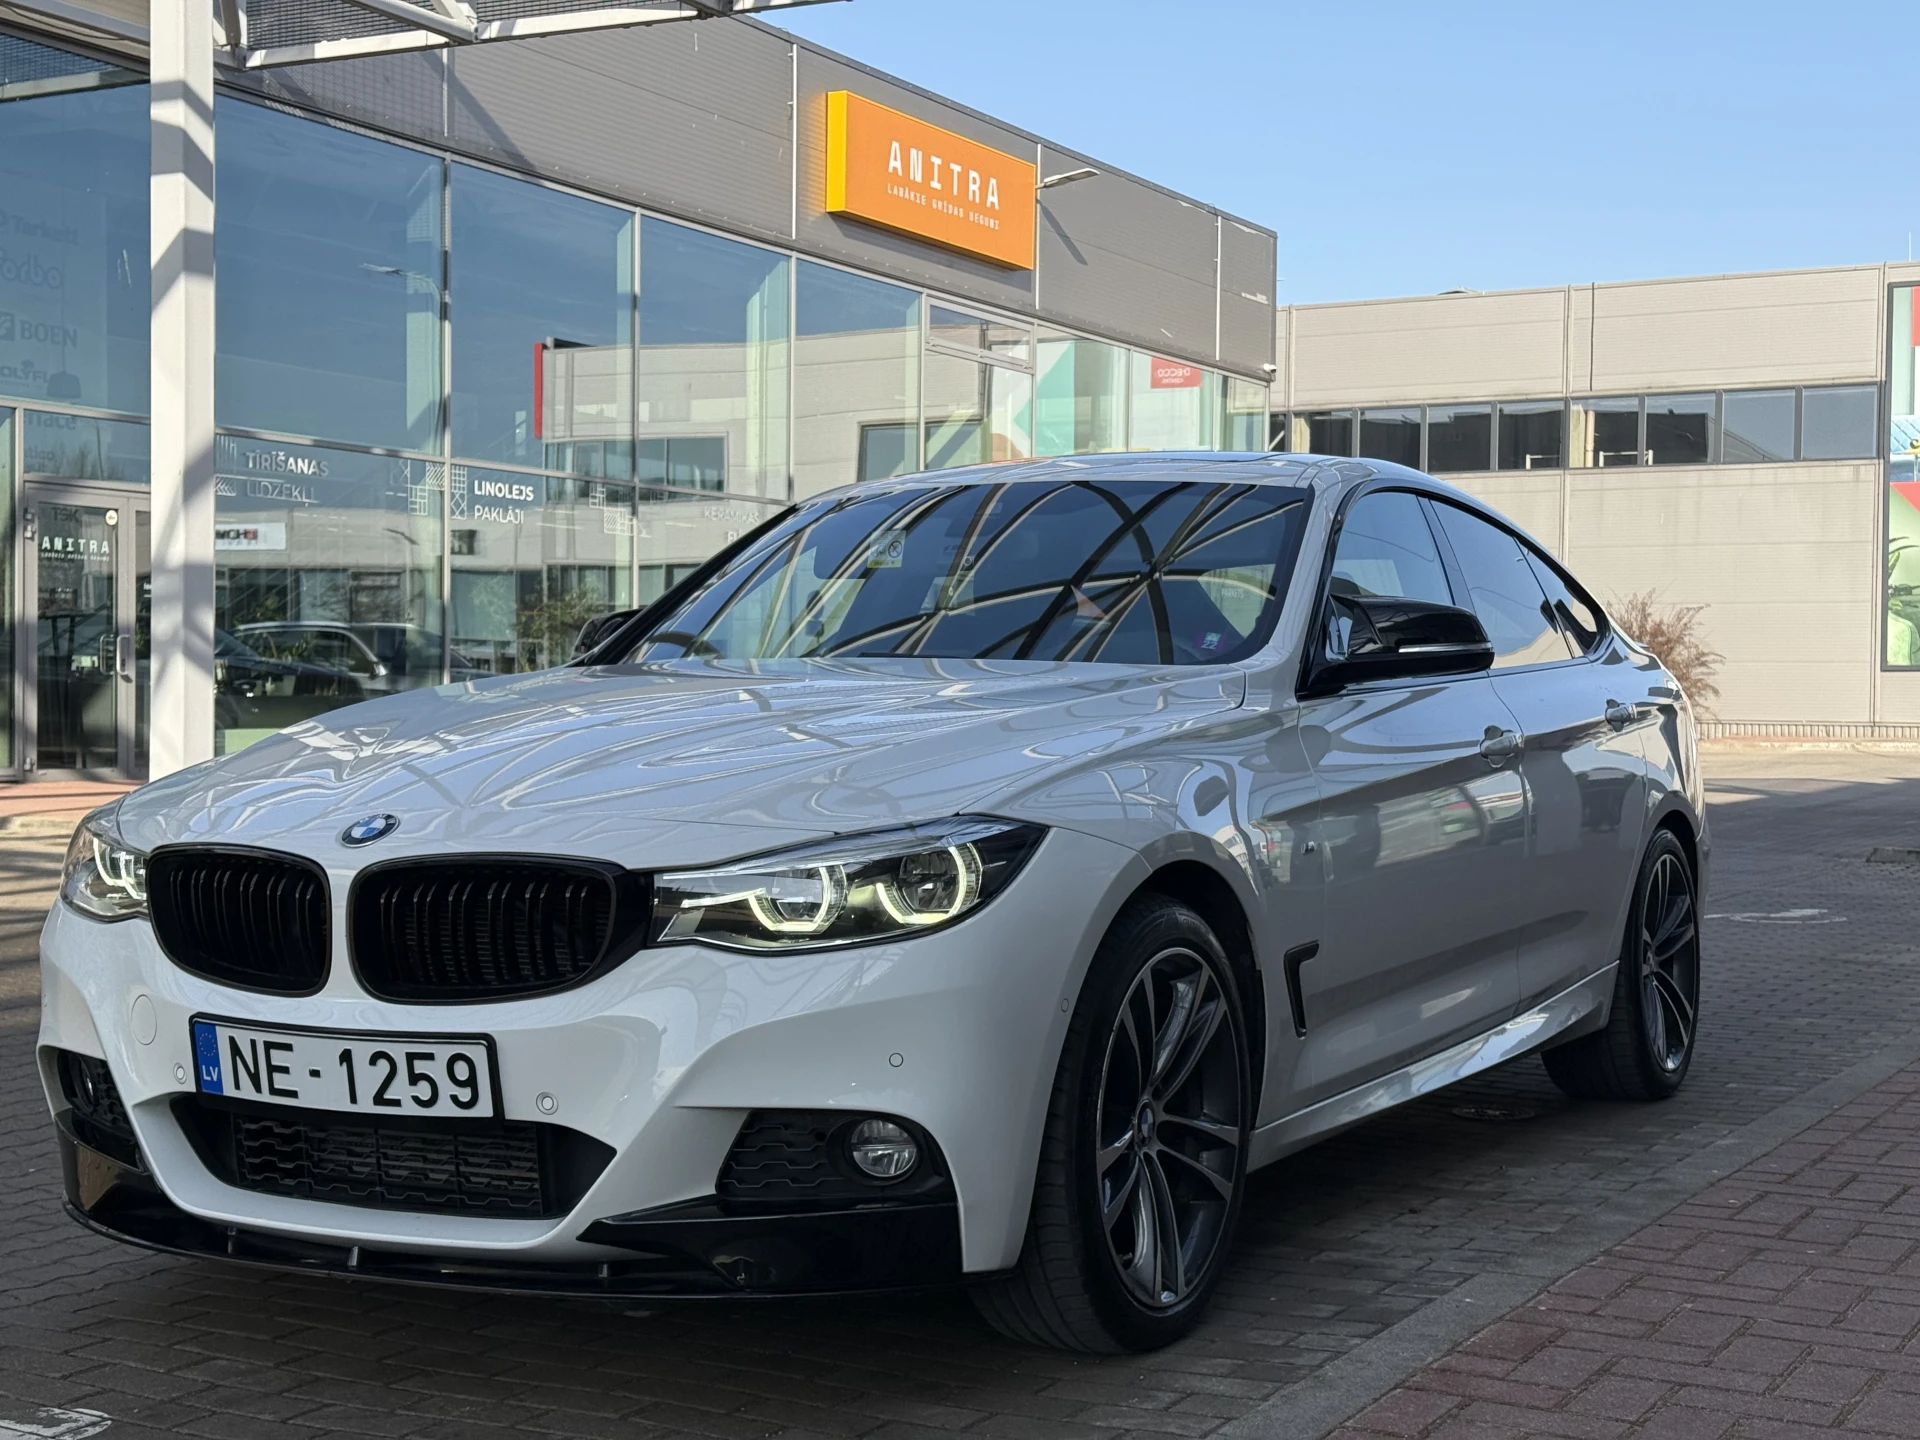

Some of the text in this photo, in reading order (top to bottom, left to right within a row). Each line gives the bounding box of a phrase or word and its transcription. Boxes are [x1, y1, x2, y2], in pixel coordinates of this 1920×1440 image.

[888, 140, 1000, 211] ANITRA
[968, 211, 1000, 231] SEGUMI
[19, 319, 78, 349] BOEN
[0, 365, 49, 383] OLYFL
[245, 450, 329, 476] TĪRĪŠANAS
[474, 479, 535, 502] LINOLEJS
[474, 505, 525, 525] PAKLĀJI
[704, 506, 760, 526] KERAMIKAS
[41, 535, 110, 555] ANITRA
[1200, 640, 1218, 650] 22
[201, 1064, 219, 1083] LV
[228, 1034, 480, 1110] NE-1259
